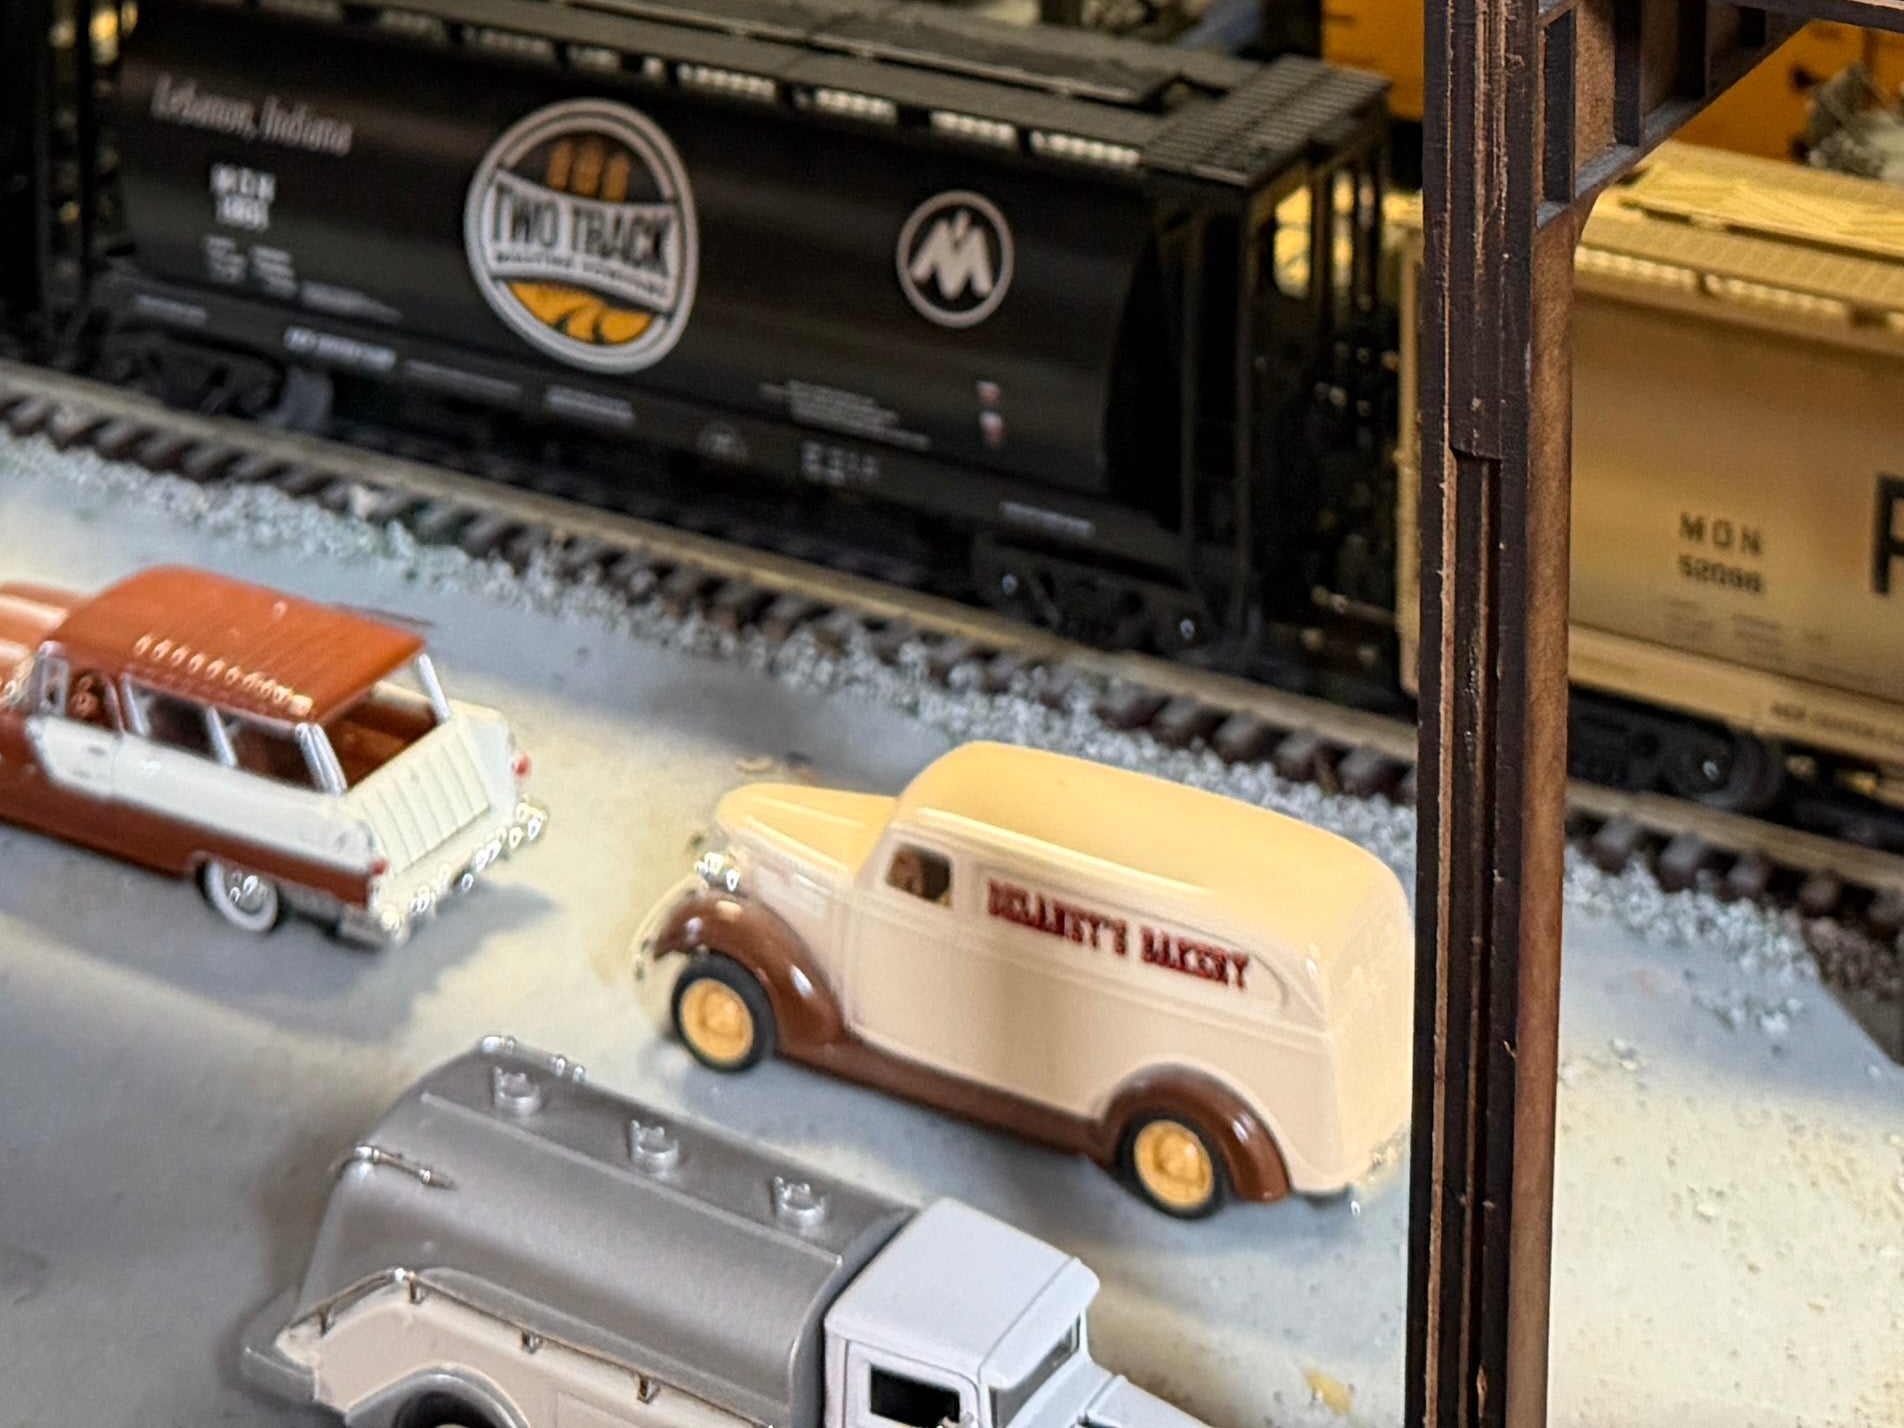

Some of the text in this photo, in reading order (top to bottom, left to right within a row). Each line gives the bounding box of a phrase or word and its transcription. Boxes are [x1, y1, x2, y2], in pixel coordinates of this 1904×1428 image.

[493, 182, 674, 279] TWO TRACK
[1680, 512, 1762, 555] MON
[1140, 925, 1250, 991] BAKERY
